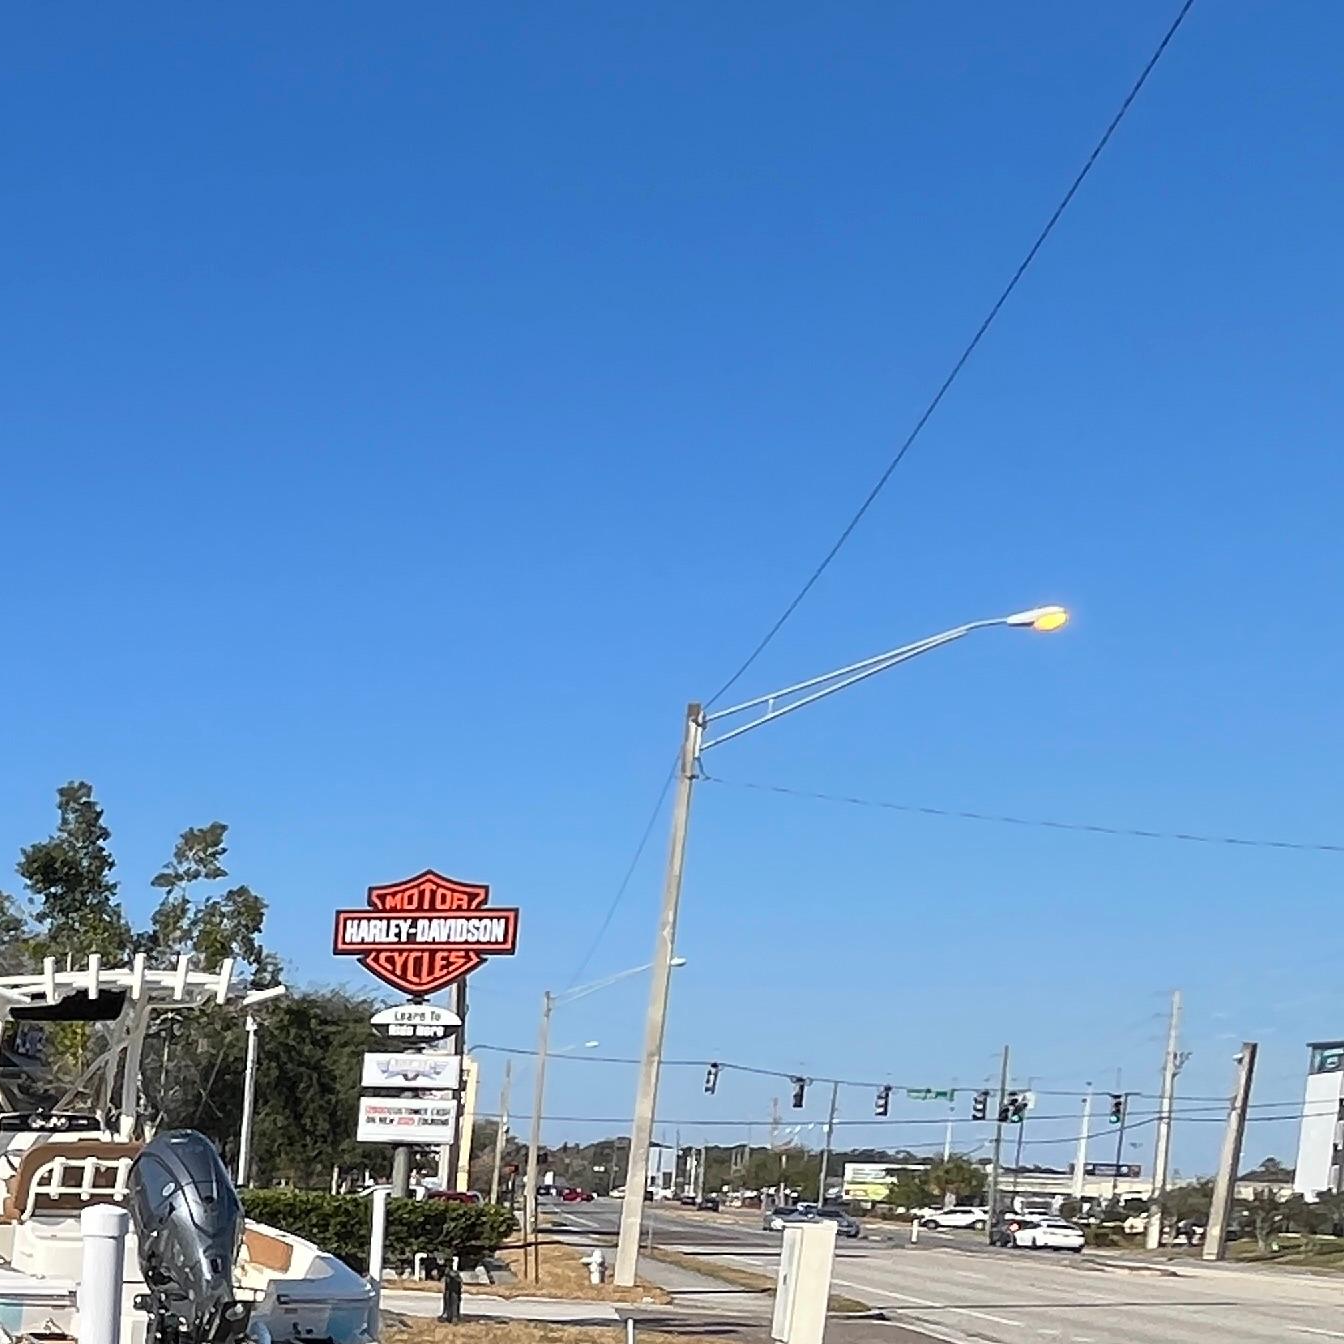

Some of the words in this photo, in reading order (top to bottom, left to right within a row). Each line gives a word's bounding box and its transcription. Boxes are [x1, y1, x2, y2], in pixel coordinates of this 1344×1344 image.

[385, 884, 468, 910] MOTOR
[344, 918, 506, 944] HARLEY-DAVIDSON
[378, 950, 467, 984] CYCLES
[395, 1011, 425, 1021] Learn
